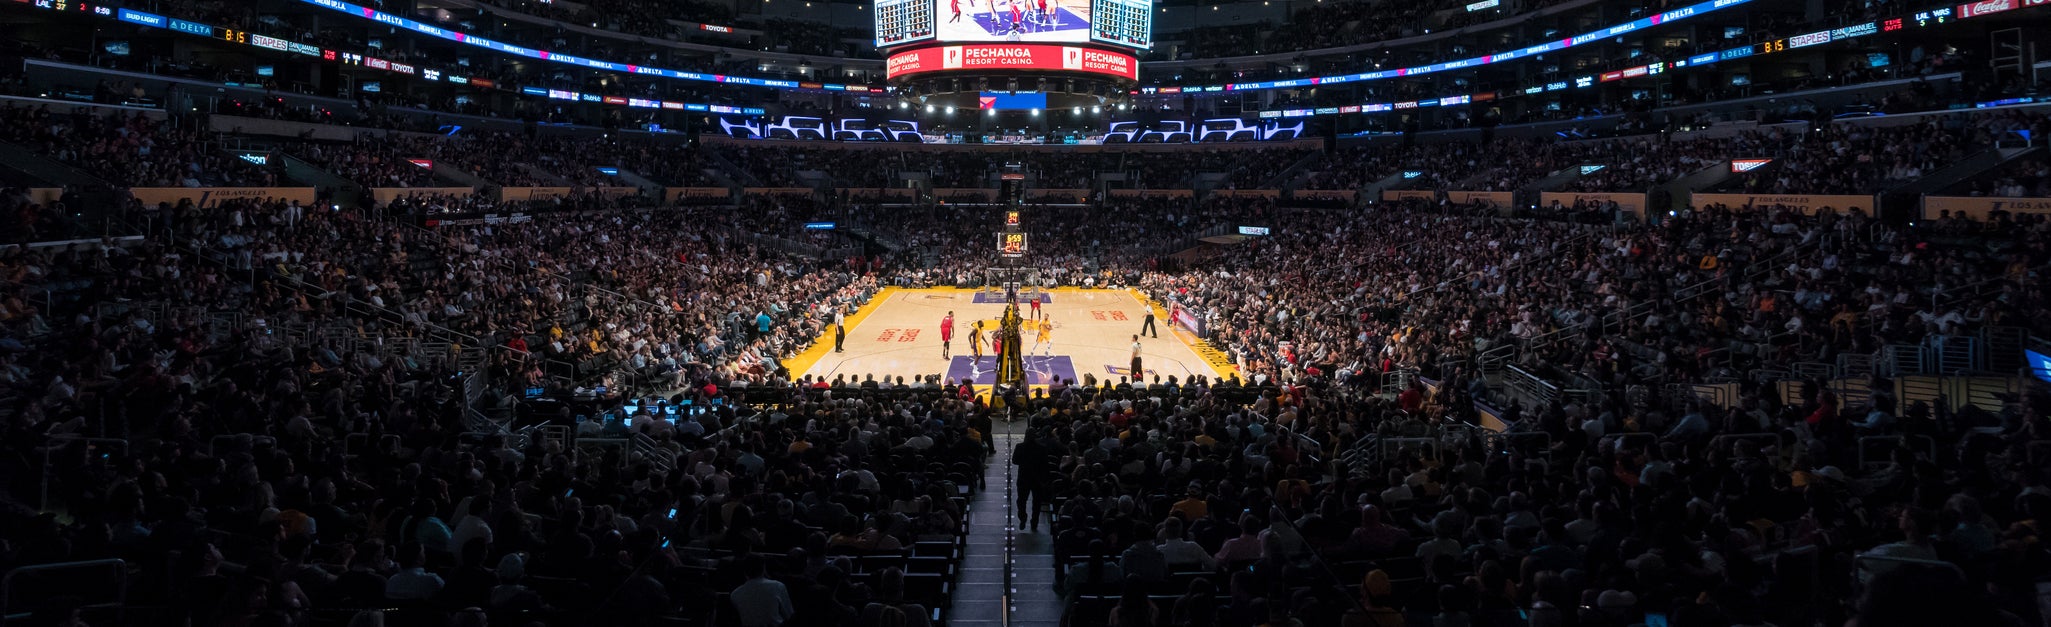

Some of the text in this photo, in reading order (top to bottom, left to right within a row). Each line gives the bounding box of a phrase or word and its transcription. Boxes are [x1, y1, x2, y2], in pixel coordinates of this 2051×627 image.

[1973, 0, 2010, 14] Coca-Cola
[126, 12, 159, 24] BUD LIGHT
[1670, 8, 1694, 18] DELTA
[1915, 12, 1930, 20] LAL
[382, 14, 403, 26] DELTA
[180, 22, 210, 34] DELTA
[1849, 22, 1876, 33] MANUEL
[226, 29, 245, 43] 8:15
[1578, 33, 1595, 44] DELTA
[1791, 32, 1829, 46] STAPLES
[253, 36, 287, 50] STAPLES
[472, 37, 490, 47] DELTA
[1765, 40, 1784, 53] 8:15
[556, 54, 574, 63] DELTA
[966, 48, 1031, 58] PECHANGA
[1085, 51, 1127, 66] PECHANGA
[1498, 52, 1513, 61] DELTA
[1727, 48, 1752, 58] DELTA
[391, 62, 414, 74] TOYOTA
[1085, 61, 1108, 69] RESORT
[448, 75, 467, 84] verizon
[1547, 82, 1567, 90] StubHub
